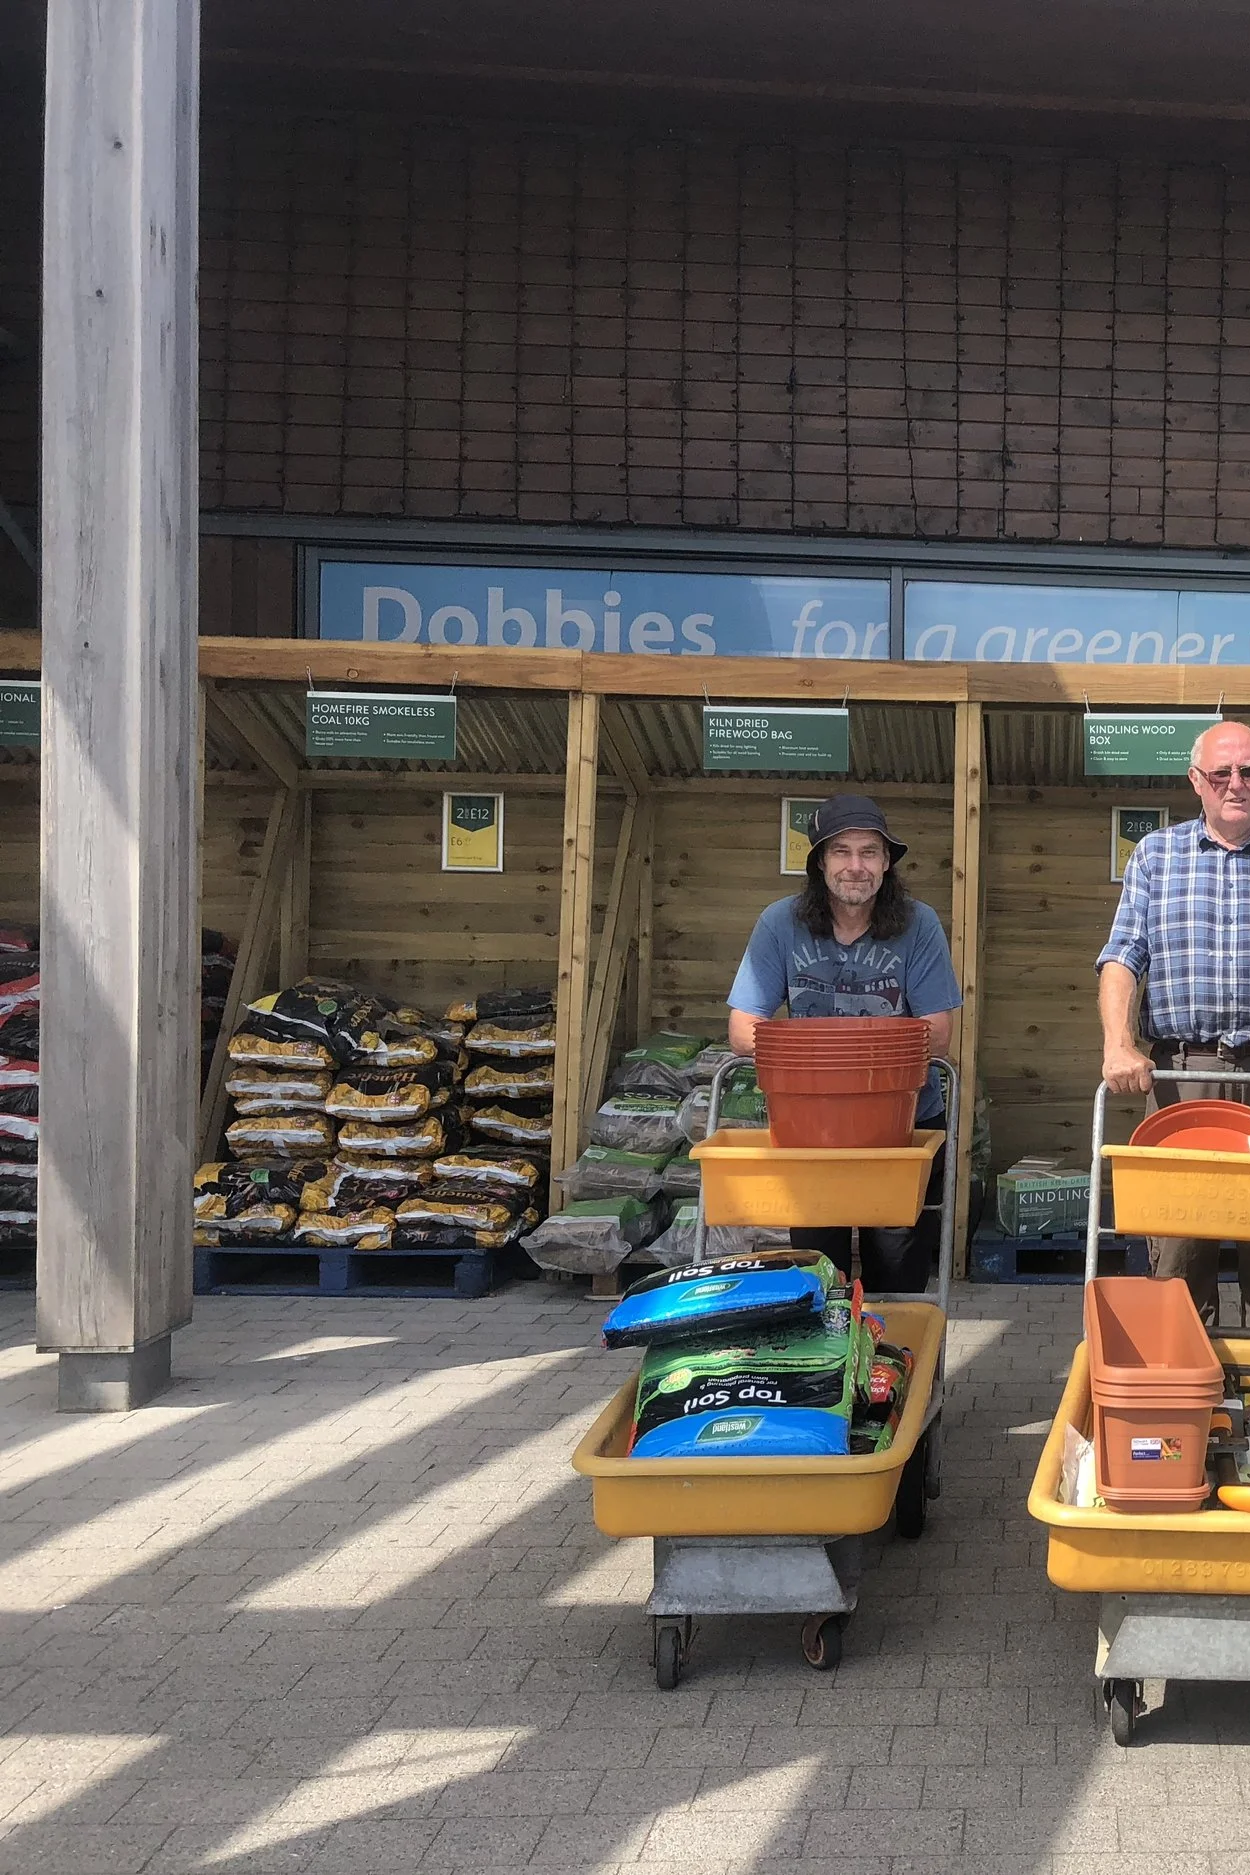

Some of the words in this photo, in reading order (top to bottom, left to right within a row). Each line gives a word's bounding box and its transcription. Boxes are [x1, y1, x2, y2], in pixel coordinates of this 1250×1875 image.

[362, 586, 716, 656] Dobbies
[793, 599, 890, 660] for
[311, 703, 370, 715] HOMEFIRE
[372, 705, 436, 717] SMOKELESS
[311, 714, 342, 725] COAL
[344, 715, 370, 726] 10KG
[709, 717, 733, 727] KILN
[736, 718, 769, 728] DRIED
[709, 728, 768, 739] FIREWOOD
[771, 730, 793, 740] BAG
[1089, 725, 1139, 735] KINDLING
[1141, 725, 1176, 735] WOOD
[1089, 735, 1111, 745] BOX
[791, 939, 830, 972] ALL
[838, 941, 902, 974] STATE
[1019, 1187, 1091, 1205] KINDLING
[720, 1259, 765, 1271] Top
[668, 1265, 714, 1283] Soil
[738, 1385, 787, 1404] Top
[683, 1390, 731, 1414] Soil
